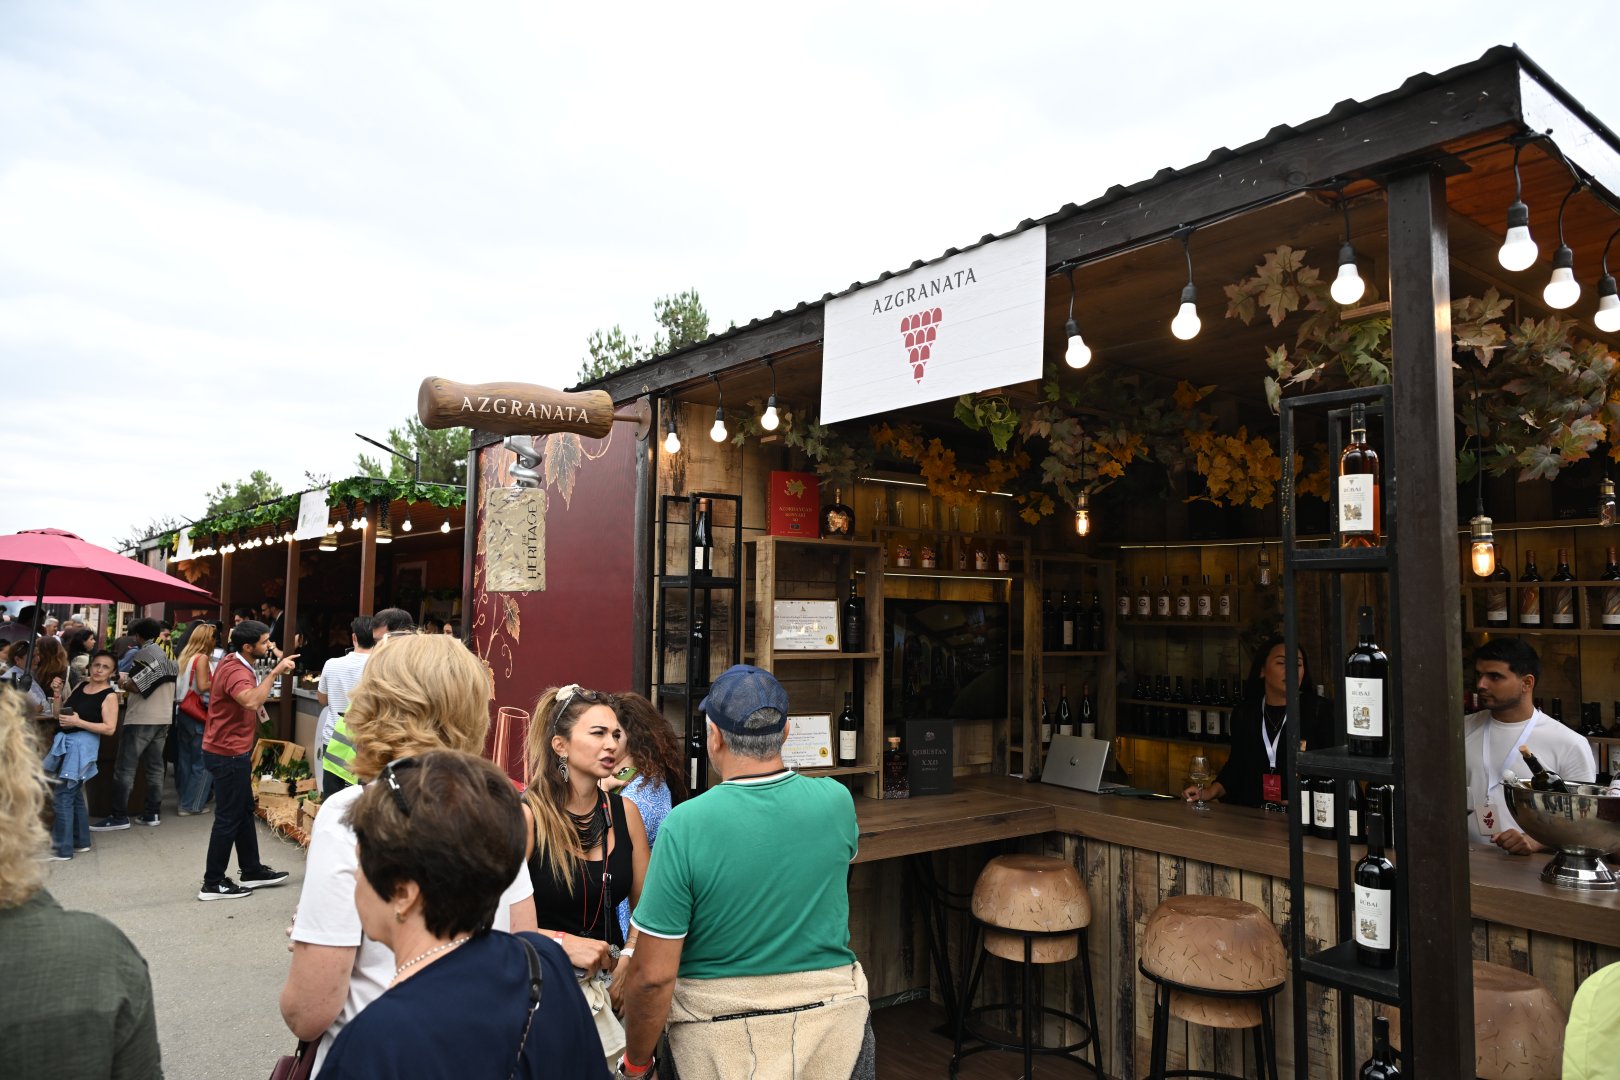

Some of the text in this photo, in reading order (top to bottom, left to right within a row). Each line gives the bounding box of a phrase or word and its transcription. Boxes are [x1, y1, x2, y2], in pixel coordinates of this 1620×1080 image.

[872, 267, 977, 316] AZGRANATA
[460, 396, 590, 424] AZGRANATA
[526, 504, 538, 580] HERITAGE
